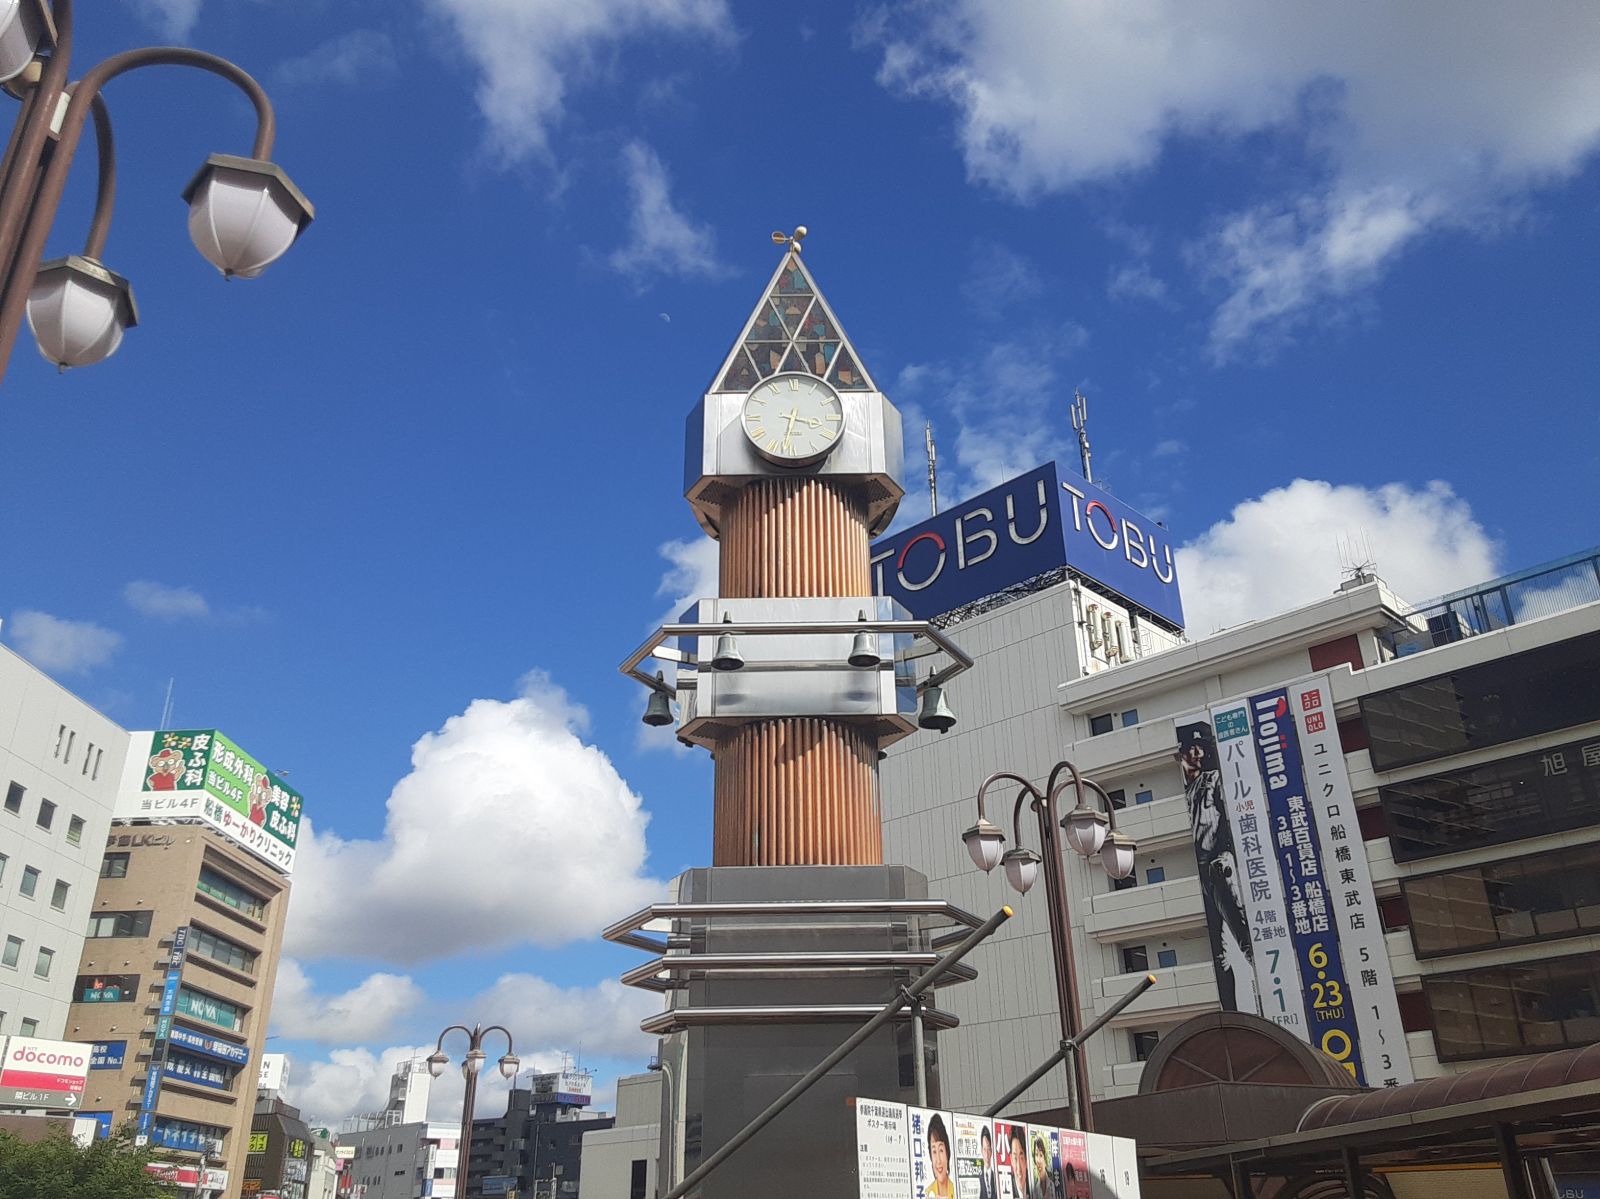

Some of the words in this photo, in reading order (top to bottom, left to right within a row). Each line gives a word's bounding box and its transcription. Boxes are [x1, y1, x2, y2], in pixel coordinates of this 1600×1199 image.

[870, 480, 1047, 597] TOBU
[1062, 482, 1173, 583] TOBU
[184, 734, 212, 787] 皮ふ科
[213, 740, 255, 787] 形成外科
[207, 769, 244, 802] 当ビル4F
[271, 785, 290, 812] 美容
[141, 797, 200, 810] 当ビル4F
[269, 811, 297, 842] 皮ふ科
[1255, 910, 1277, 925] 4階
[1252, 925, 1287, 942] 2番地
[13, 1046, 84, 1067] docomo
